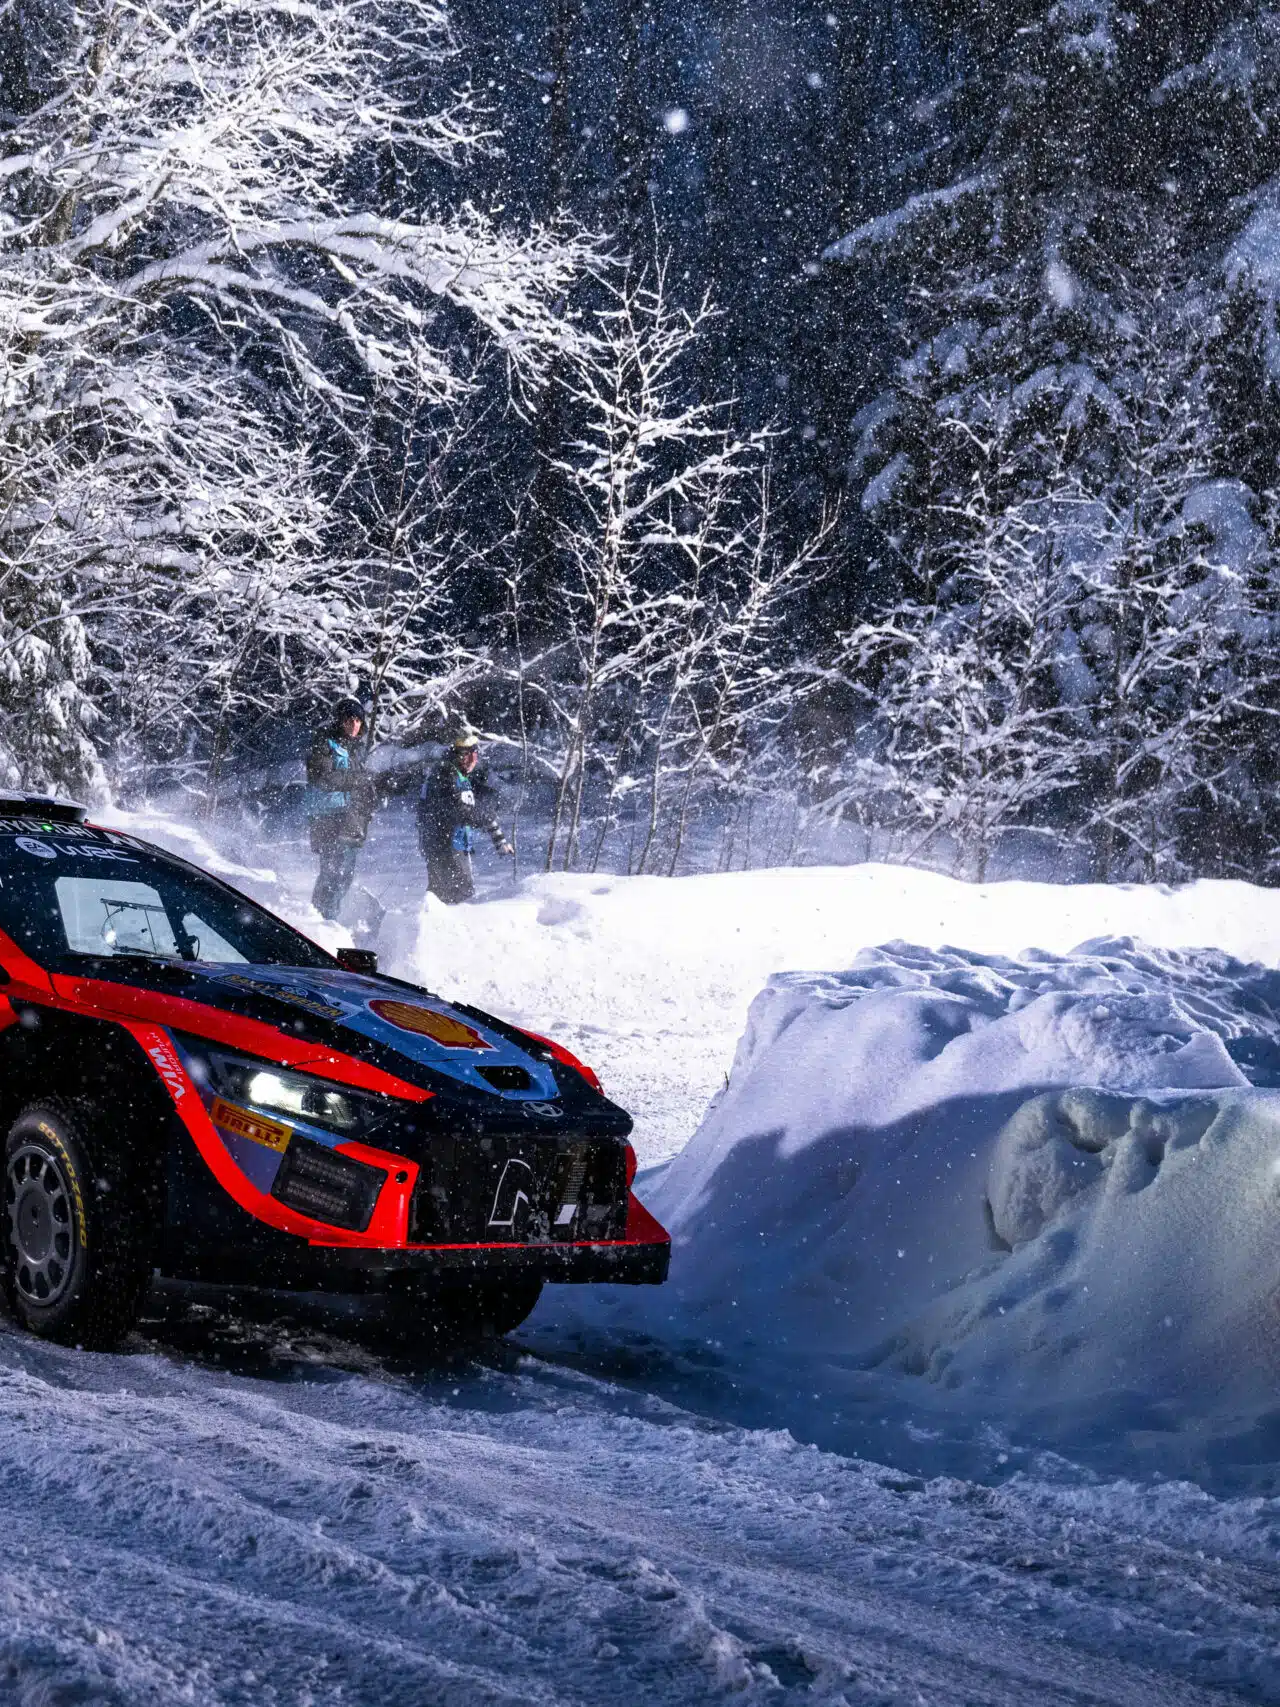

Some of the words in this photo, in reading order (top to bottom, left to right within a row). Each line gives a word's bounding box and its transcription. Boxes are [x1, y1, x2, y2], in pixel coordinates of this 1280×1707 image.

[53, 842, 140, 863] WRC
[148, 1047, 186, 1100] WIA
[216, 1103, 285, 1146] PIRELLI
[38, 1120, 88, 1248] SOTTOZERO
